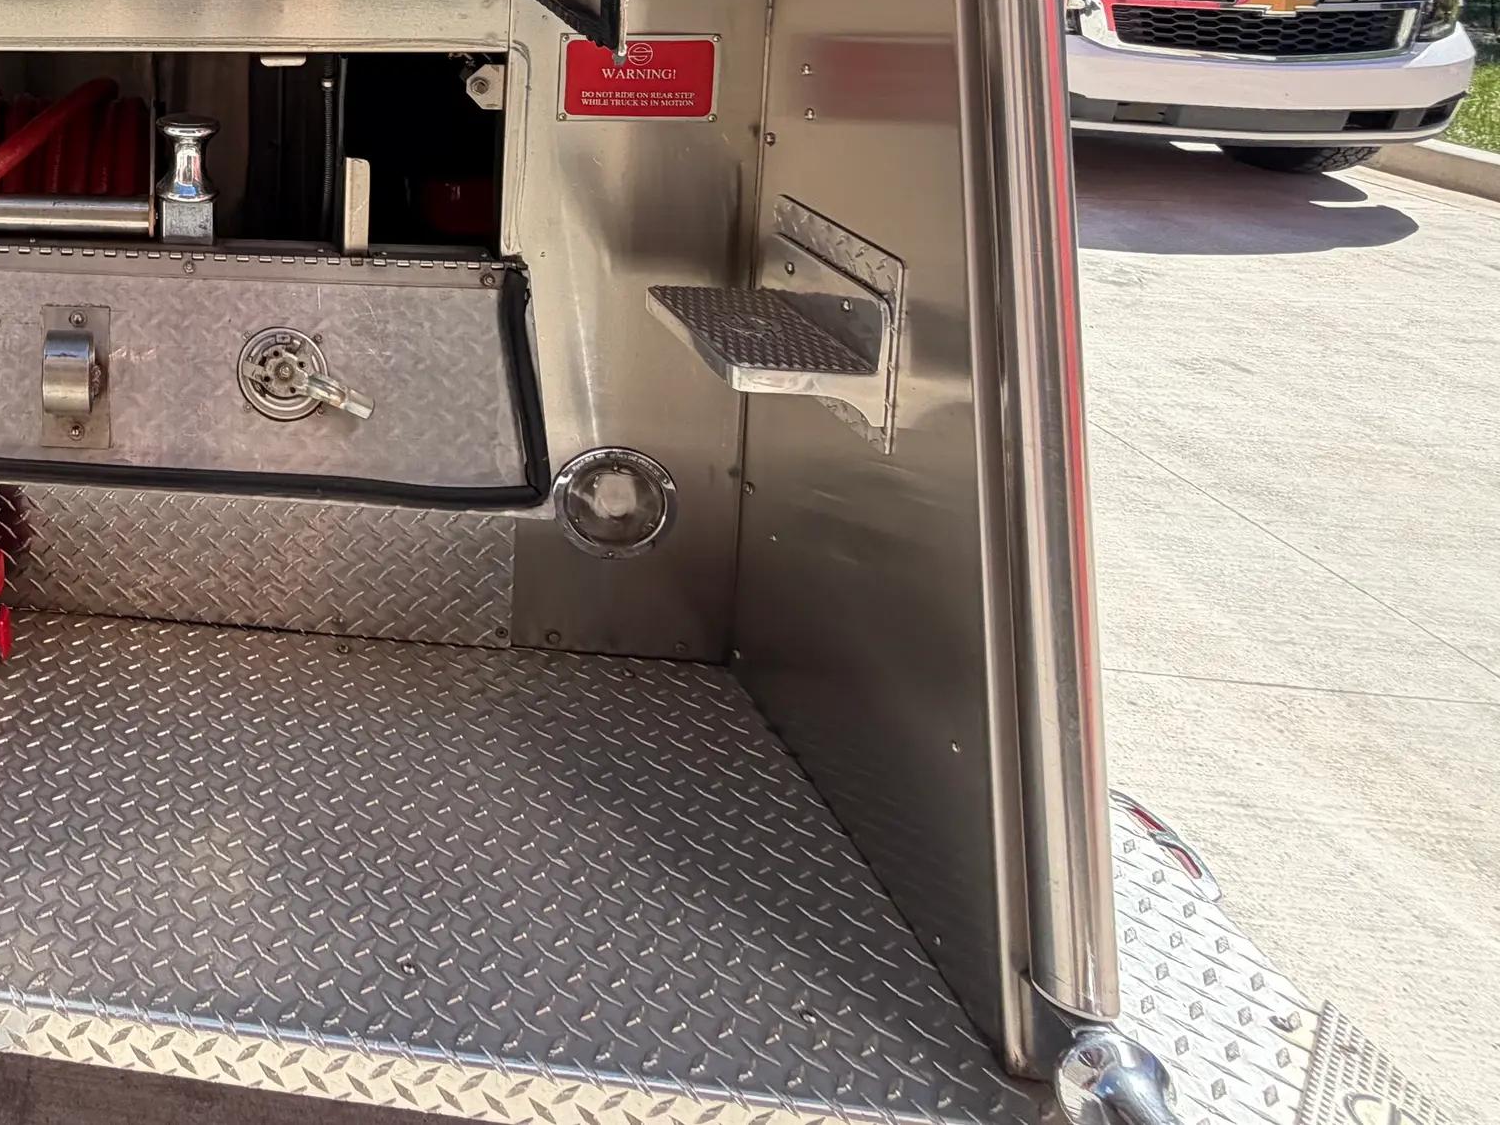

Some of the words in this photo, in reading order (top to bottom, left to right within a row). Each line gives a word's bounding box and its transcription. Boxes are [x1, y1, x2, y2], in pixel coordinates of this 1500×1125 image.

[601, 68, 677, 80] WARNING!
[615, 91, 635, 99] RIDE
[636, 91, 649, 99] ON
[650, 91, 673, 99] REAR
[581, 98, 609, 106] WHILE
[611, 98, 639, 106] TRUCK
[640, 98, 649, 106] IS
[660, 99, 694, 107] MOTION
